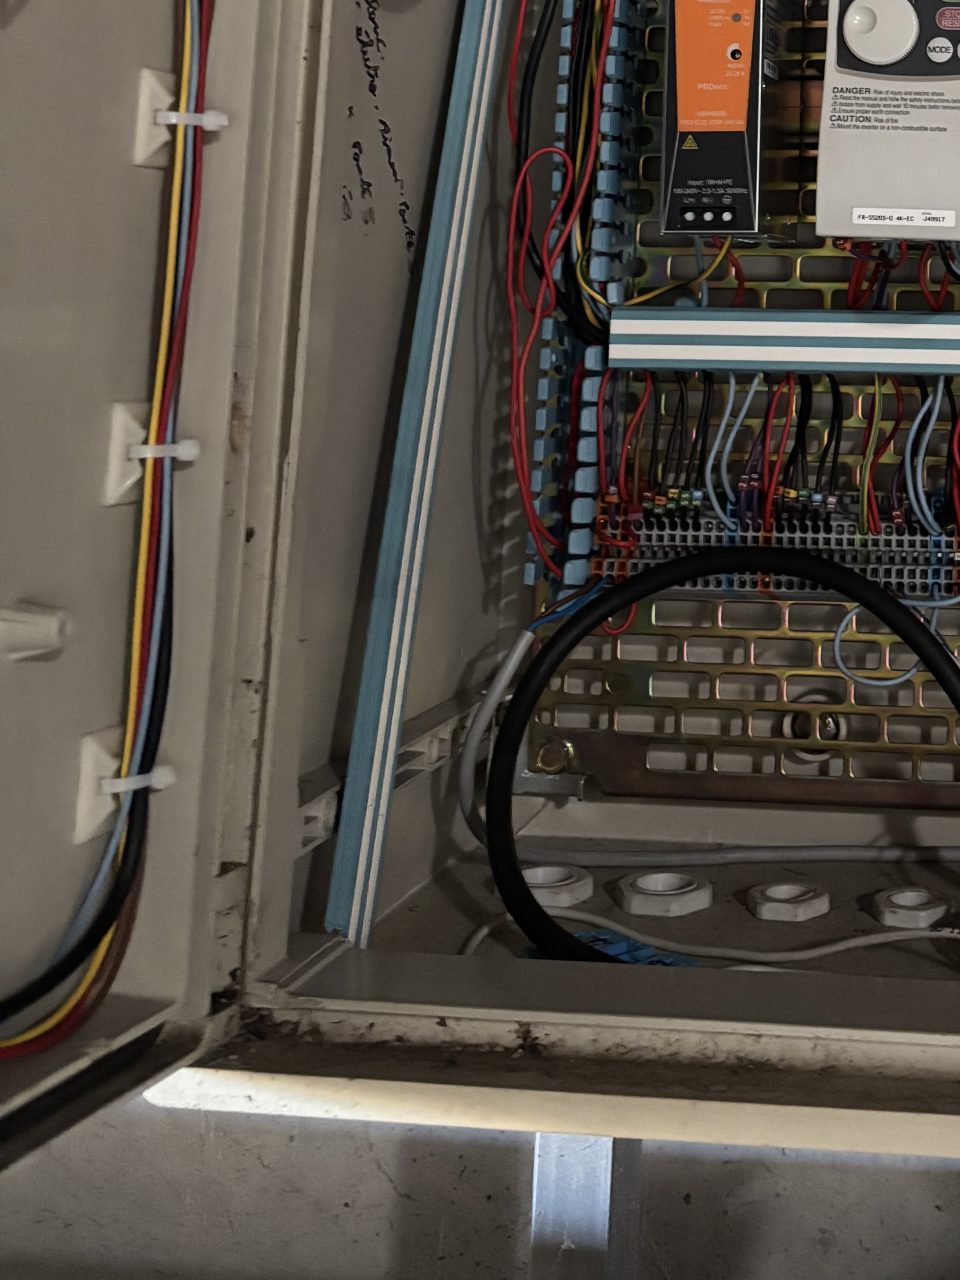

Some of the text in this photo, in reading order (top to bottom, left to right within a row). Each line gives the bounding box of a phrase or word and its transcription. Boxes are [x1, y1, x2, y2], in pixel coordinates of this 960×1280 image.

[928, 46, 952, 54] MODE
[832, 87, 871, 95] DANGER
[830, 115, 871, 123] CAUTION
